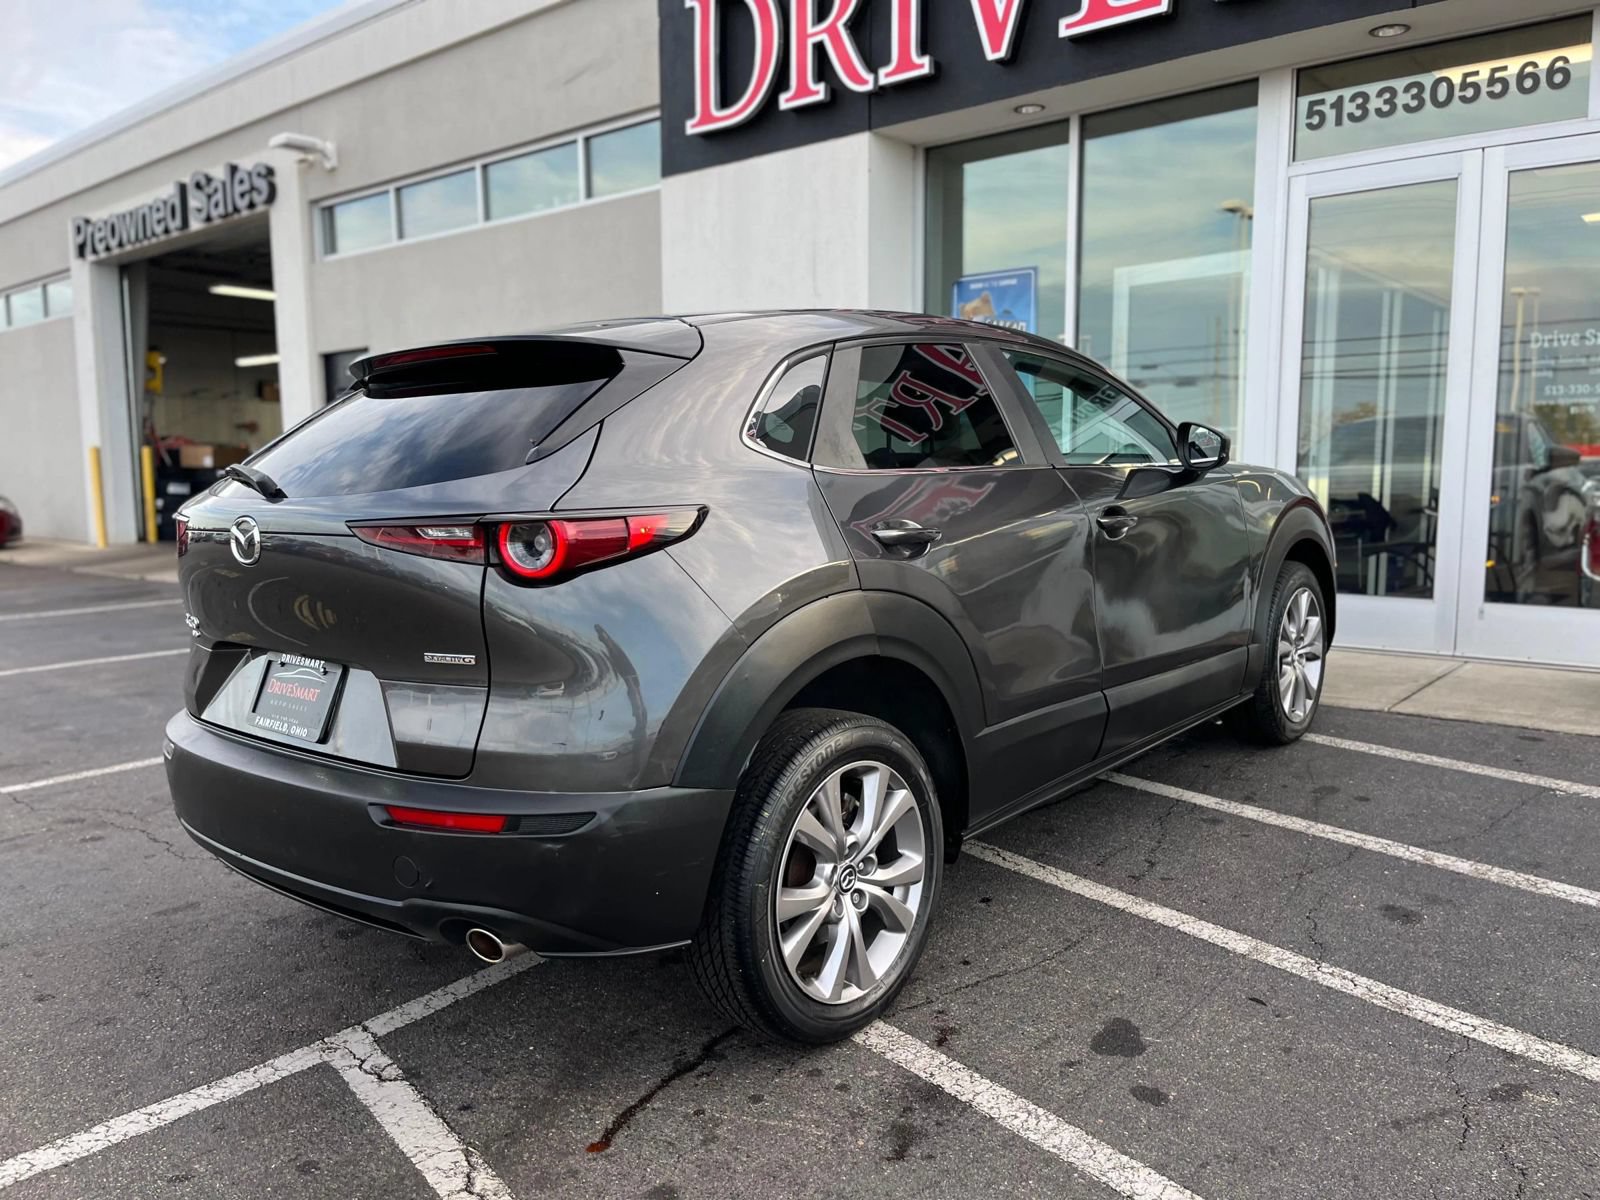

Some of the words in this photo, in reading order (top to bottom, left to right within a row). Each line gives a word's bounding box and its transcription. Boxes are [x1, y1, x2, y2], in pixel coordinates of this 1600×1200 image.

[685, 0, 1169, 135] DRI
[1305, 55, 1572, 131] 5133305566
[72, 181, 190, 260] Preowned
[189, 162, 277, 225] Sales
[1530, 329, 1580, 349] Drive
[1585, 328, 1600, 346] S
[281, 653, 326, 670] DRIVESMART
[255, 715, 289, 735] FAIRFIELD,
[290, 725, 308, 737] OHIO
